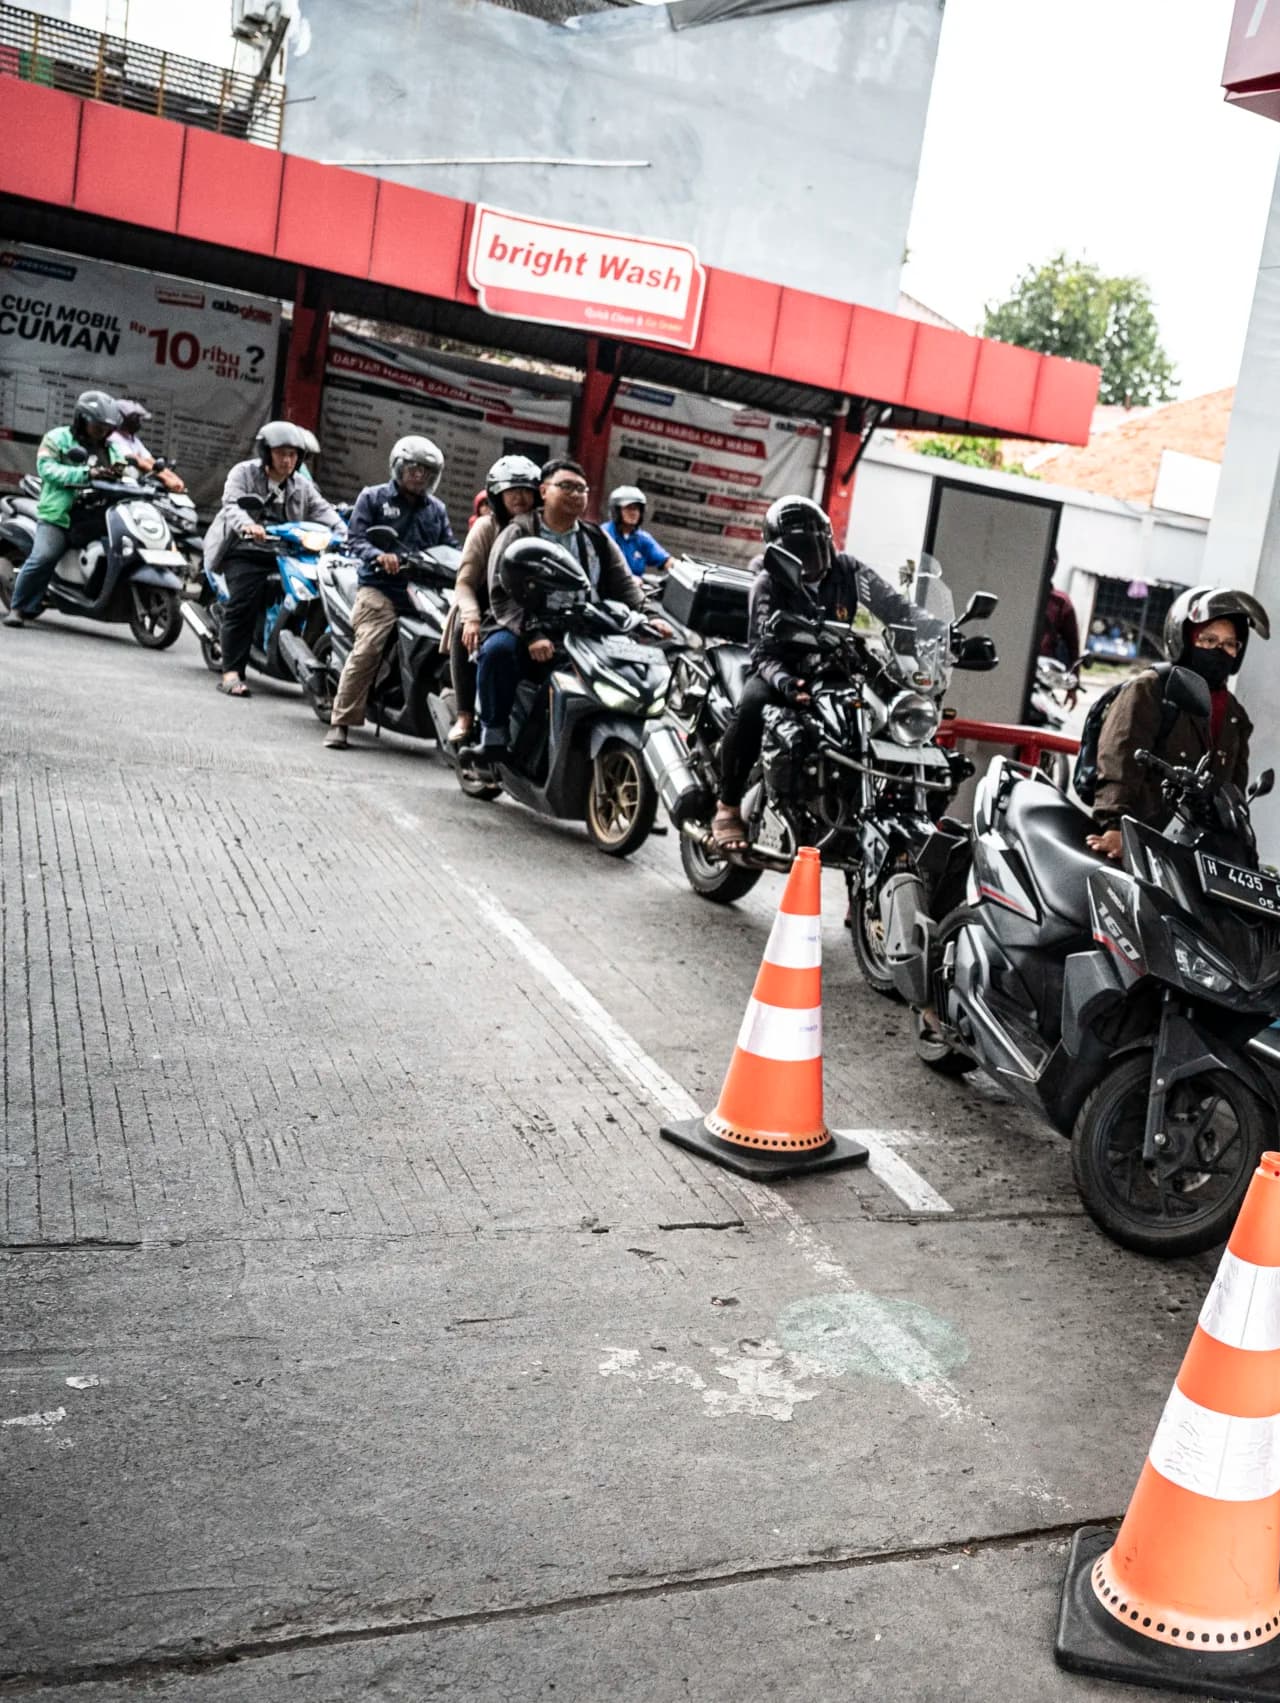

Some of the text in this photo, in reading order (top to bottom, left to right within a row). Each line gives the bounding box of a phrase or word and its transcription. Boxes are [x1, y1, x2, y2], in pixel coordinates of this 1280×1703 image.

[487, 234, 682, 293] bright Wash
[0, 311, 121, 356] CUMAN
[1, 294, 121, 332] CUCI MOBIL
[129, 320, 265, 373] Rp 10 ribu ?
[622, 414, 759, 454] DAFTAR HARGA CAR WASH
[1207, 859, 1218, 877] H
[1228, 868, 1263, 892] 4435
[1098, 901, 1141, 960] 160
